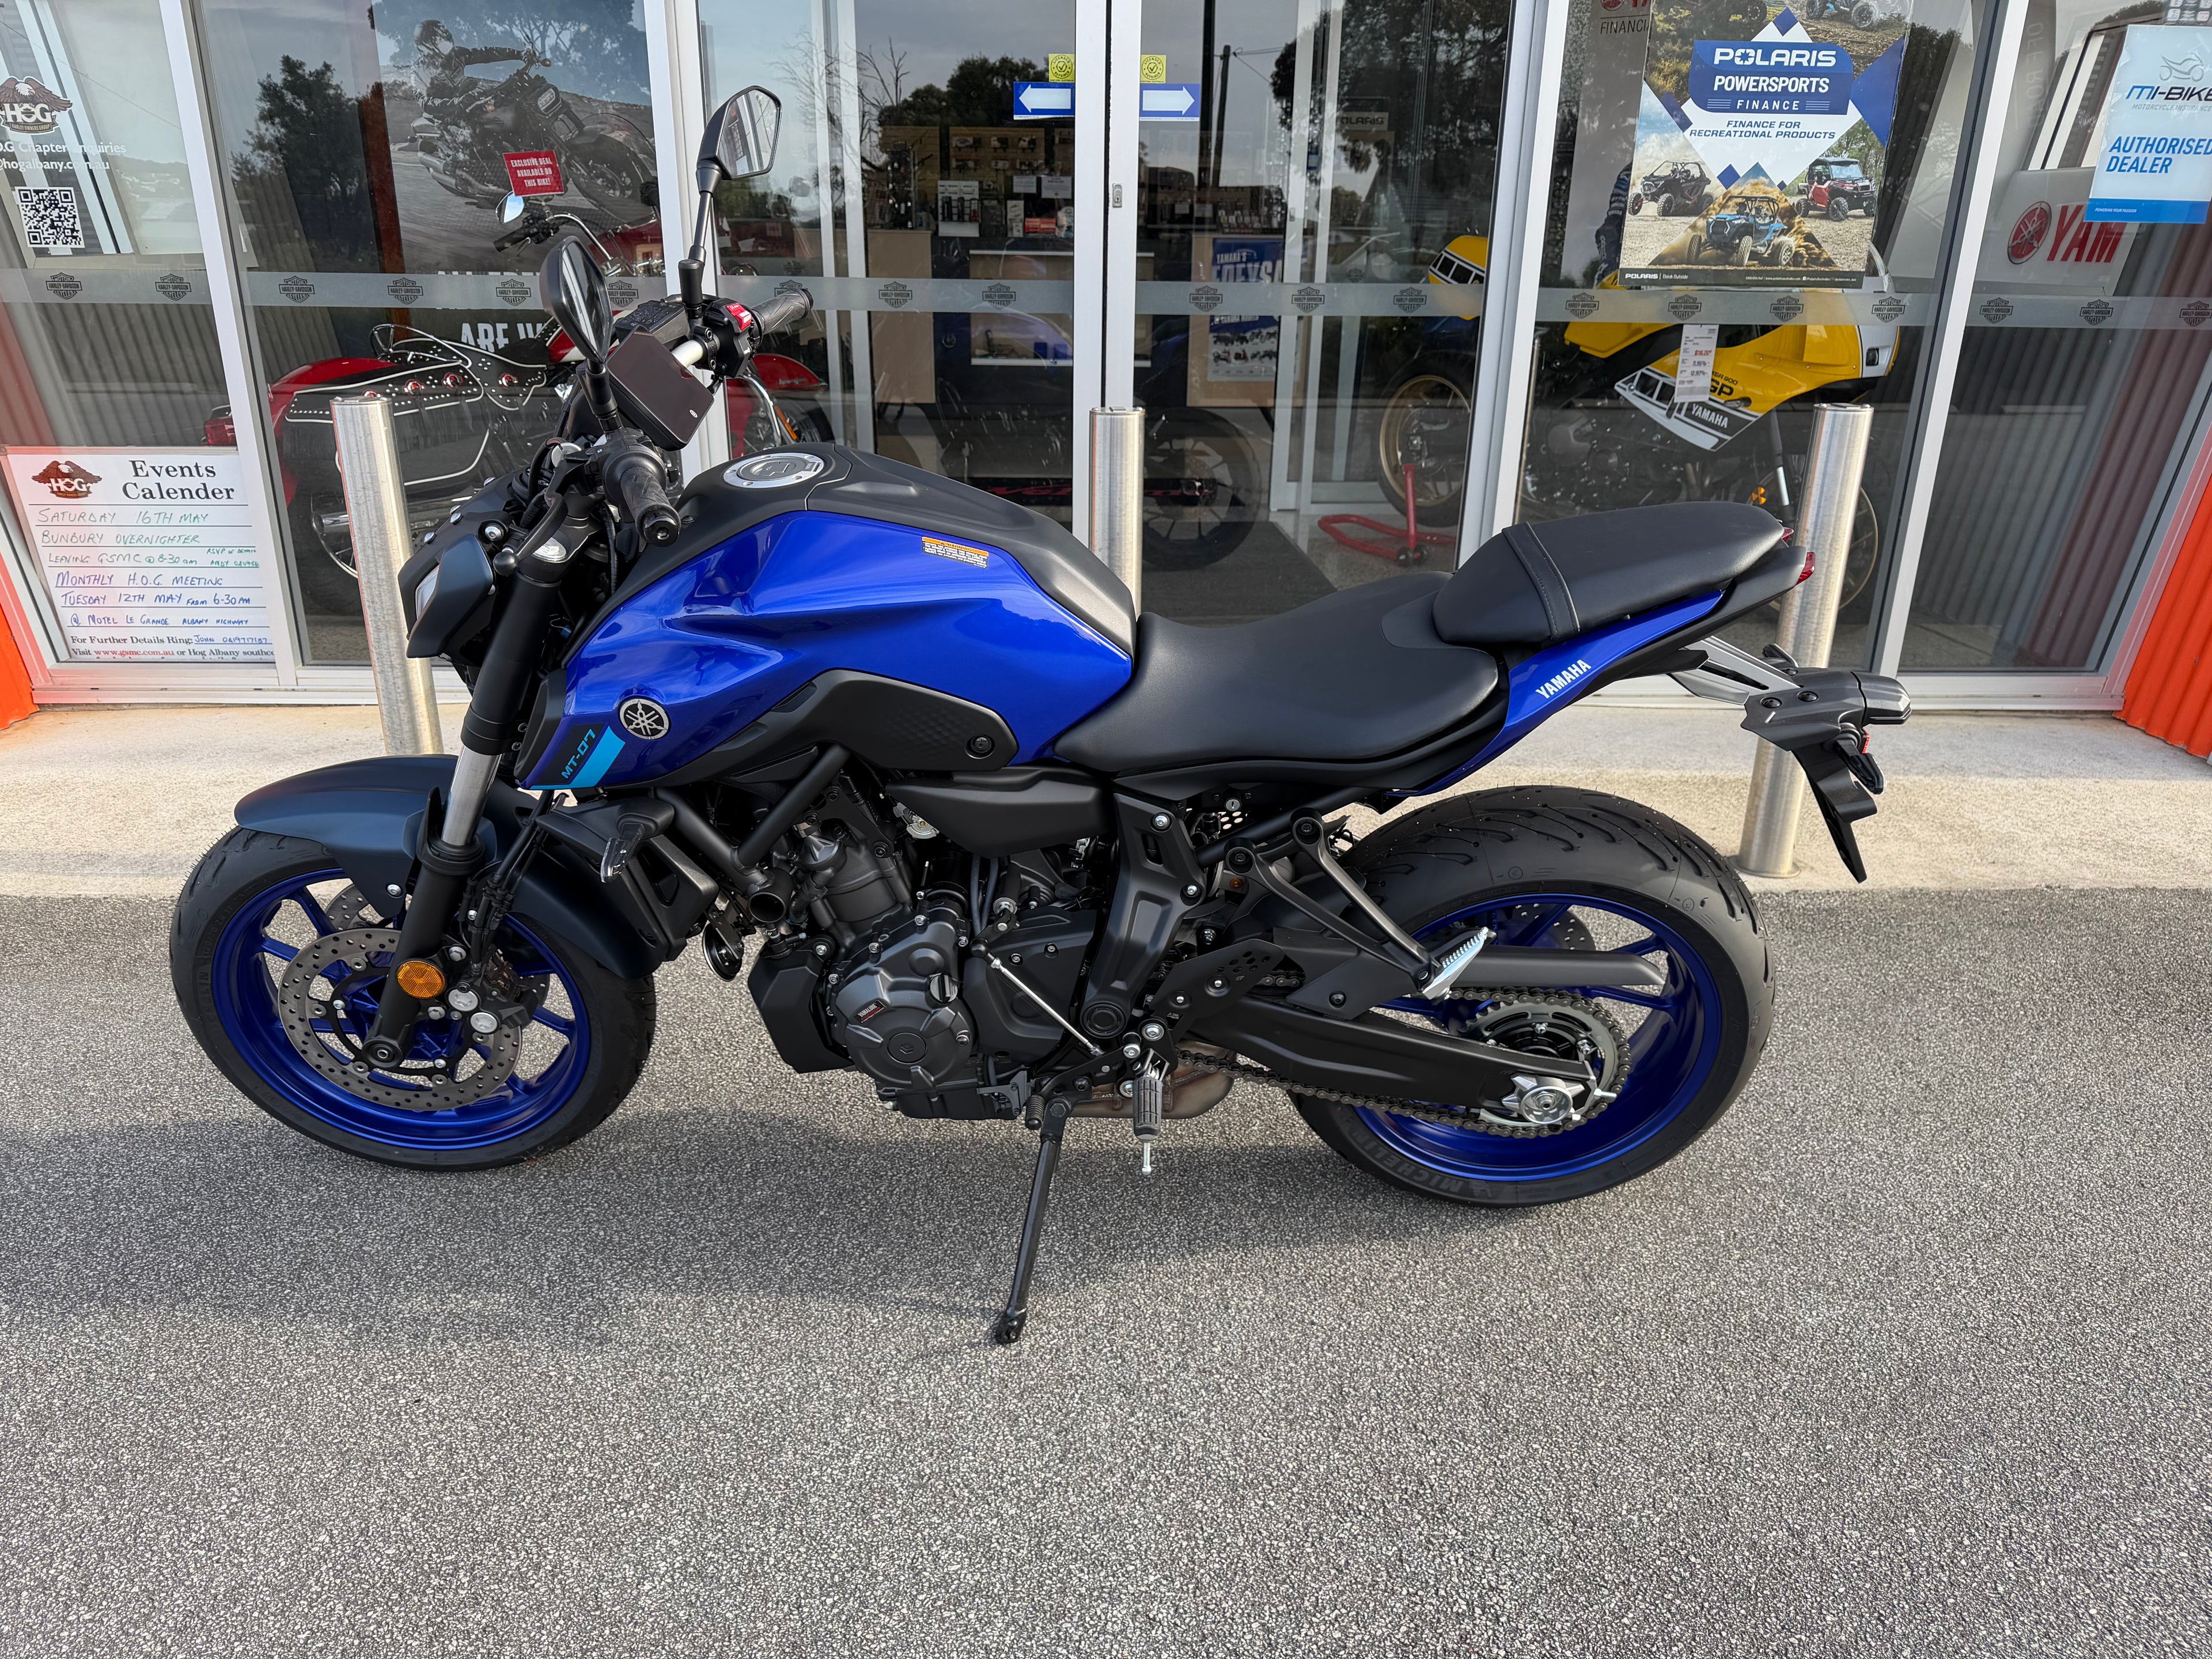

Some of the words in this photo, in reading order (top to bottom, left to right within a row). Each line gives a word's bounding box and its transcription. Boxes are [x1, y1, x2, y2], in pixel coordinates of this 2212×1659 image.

[1714, 48, 1836, 67] POLARIS
[1714, 75, 1830, 93] POWERSPORTS
[1737, 100, 1800, 110] FINANCE
[1690, 130, 1772, 138] RECREATIONAL
[1775, 131, 1836, 139] PRODUCTS
[18, 143, 66, 156] Chapter
[2109, 136, 2212, 156] AUTHORISED
[510, 157, 539, 167] EXCLUSIVE
[539, 157, 552, 165] DEAL
[2106, 156, 2173, 173] DEALER
[517, 168, 544, 177] AVAILABLE
[524, 179, 536, 187] THIS
[537, 178, 551, 186] BIKE!
[1709, 377, 1734, 396] GP
[1692, 403, 1728, 428] YAMAHA
[129, 460, 216, 477] Events
[122, 482, 234, 499] Calender
[38, 507, 116, 524] SATURDAY
[136, 511, 173, 524] 16TH
[179, 513, 208, 523] MAY
[41, 530, 104, 544] BUNBURY
[115, 533, 200, 545] OVERNIGHTER
[48, 553, 90, 563] LEAVING
[97, 553, 142, 564] GSMC
[56, 571, 113, 586] MONTHLY
[127, 573, 163, 586] H.O.G.
[172, 576, 223, 586] MEETING
[61, 590, 106, 605] TUESDAY
[118, 593, 145, 603] 12TH
[154, 593, 182, 604] MAY
[213, 593, 237, 605] 6-30
[70, 613, 81, 627] @
[88, 614, 118, 626] MOTEL
[126, 615, 134, 624] LE
[141, 614, 169, 625] GRANDE
[70, 636, 86, 644] For
[89, 636, 128, 644] Further
[130, 636, 164, 644] Details
[167, 637, 194, 645] Ring:
[194, 635, 215, 643] JOHN
[94, 650, 175, 658] www.gsmc.com.au
[188, 649, 206, 657] Hog
[1535, 659, 1592, 699] YAMAHA
[561, 729, 596, 779] MT-07
